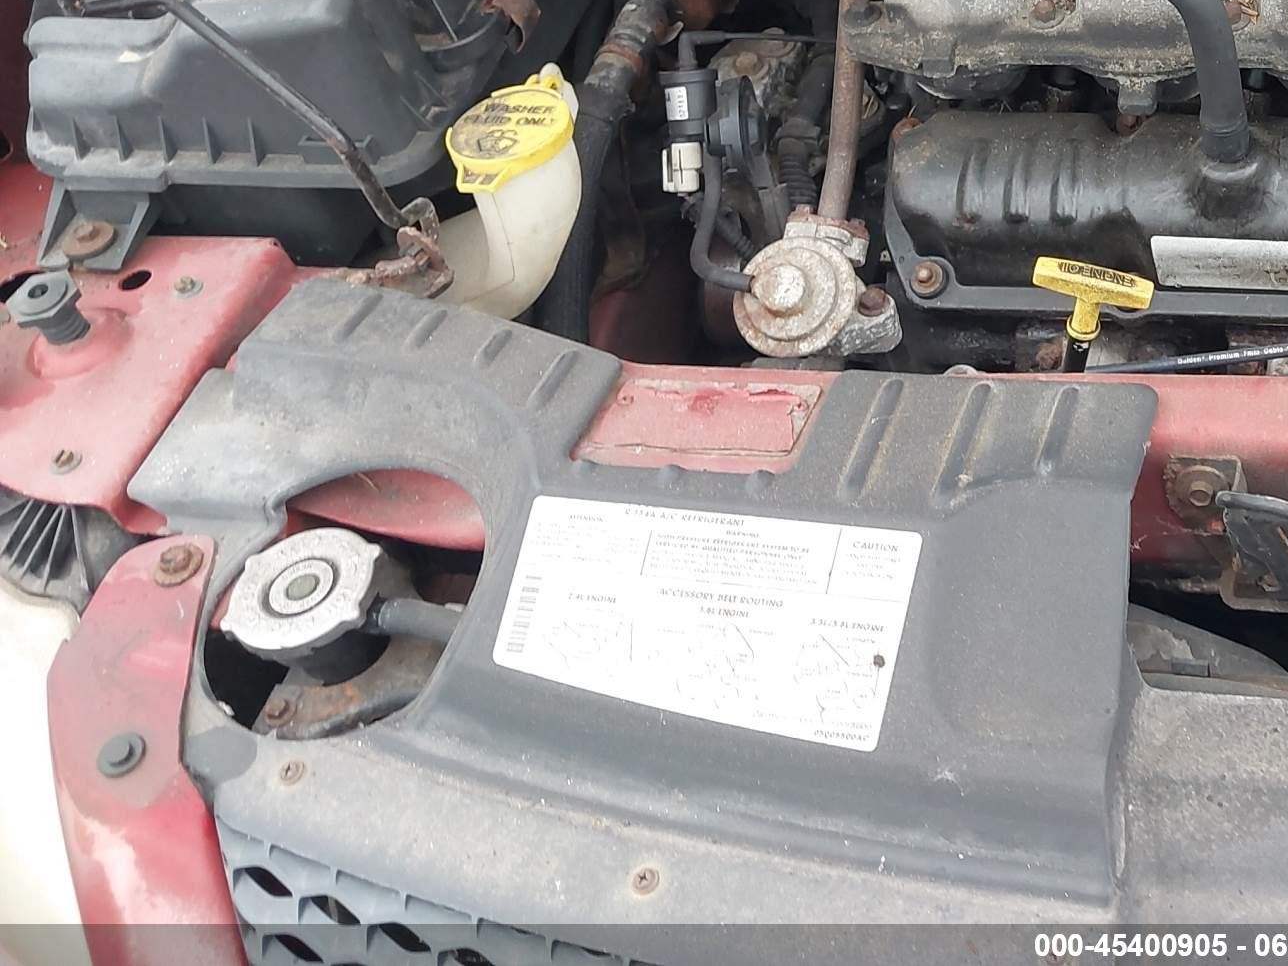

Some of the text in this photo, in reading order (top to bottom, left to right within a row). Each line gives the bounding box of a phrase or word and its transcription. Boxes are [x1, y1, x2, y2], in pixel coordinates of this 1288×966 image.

[483, 102, 556, 115] WASHER
[462, 114, 512, 125] FLUID
[1081, 265, 1137, 288] ENGINE
[1208, 352, 1240, 362] Premium
[682, 513, 744, 527] REFRIGERANT
[852, 541, 900, 552] CAUTION
[586, 594, 617, 604] ENGINE
[659, 587, 714, 602] ACCESSORY
[741, 596, 784, 608] ROUTING
[718, 608, 749, 619] ENGINE
[852, 622, 885, 633] ENGINE
